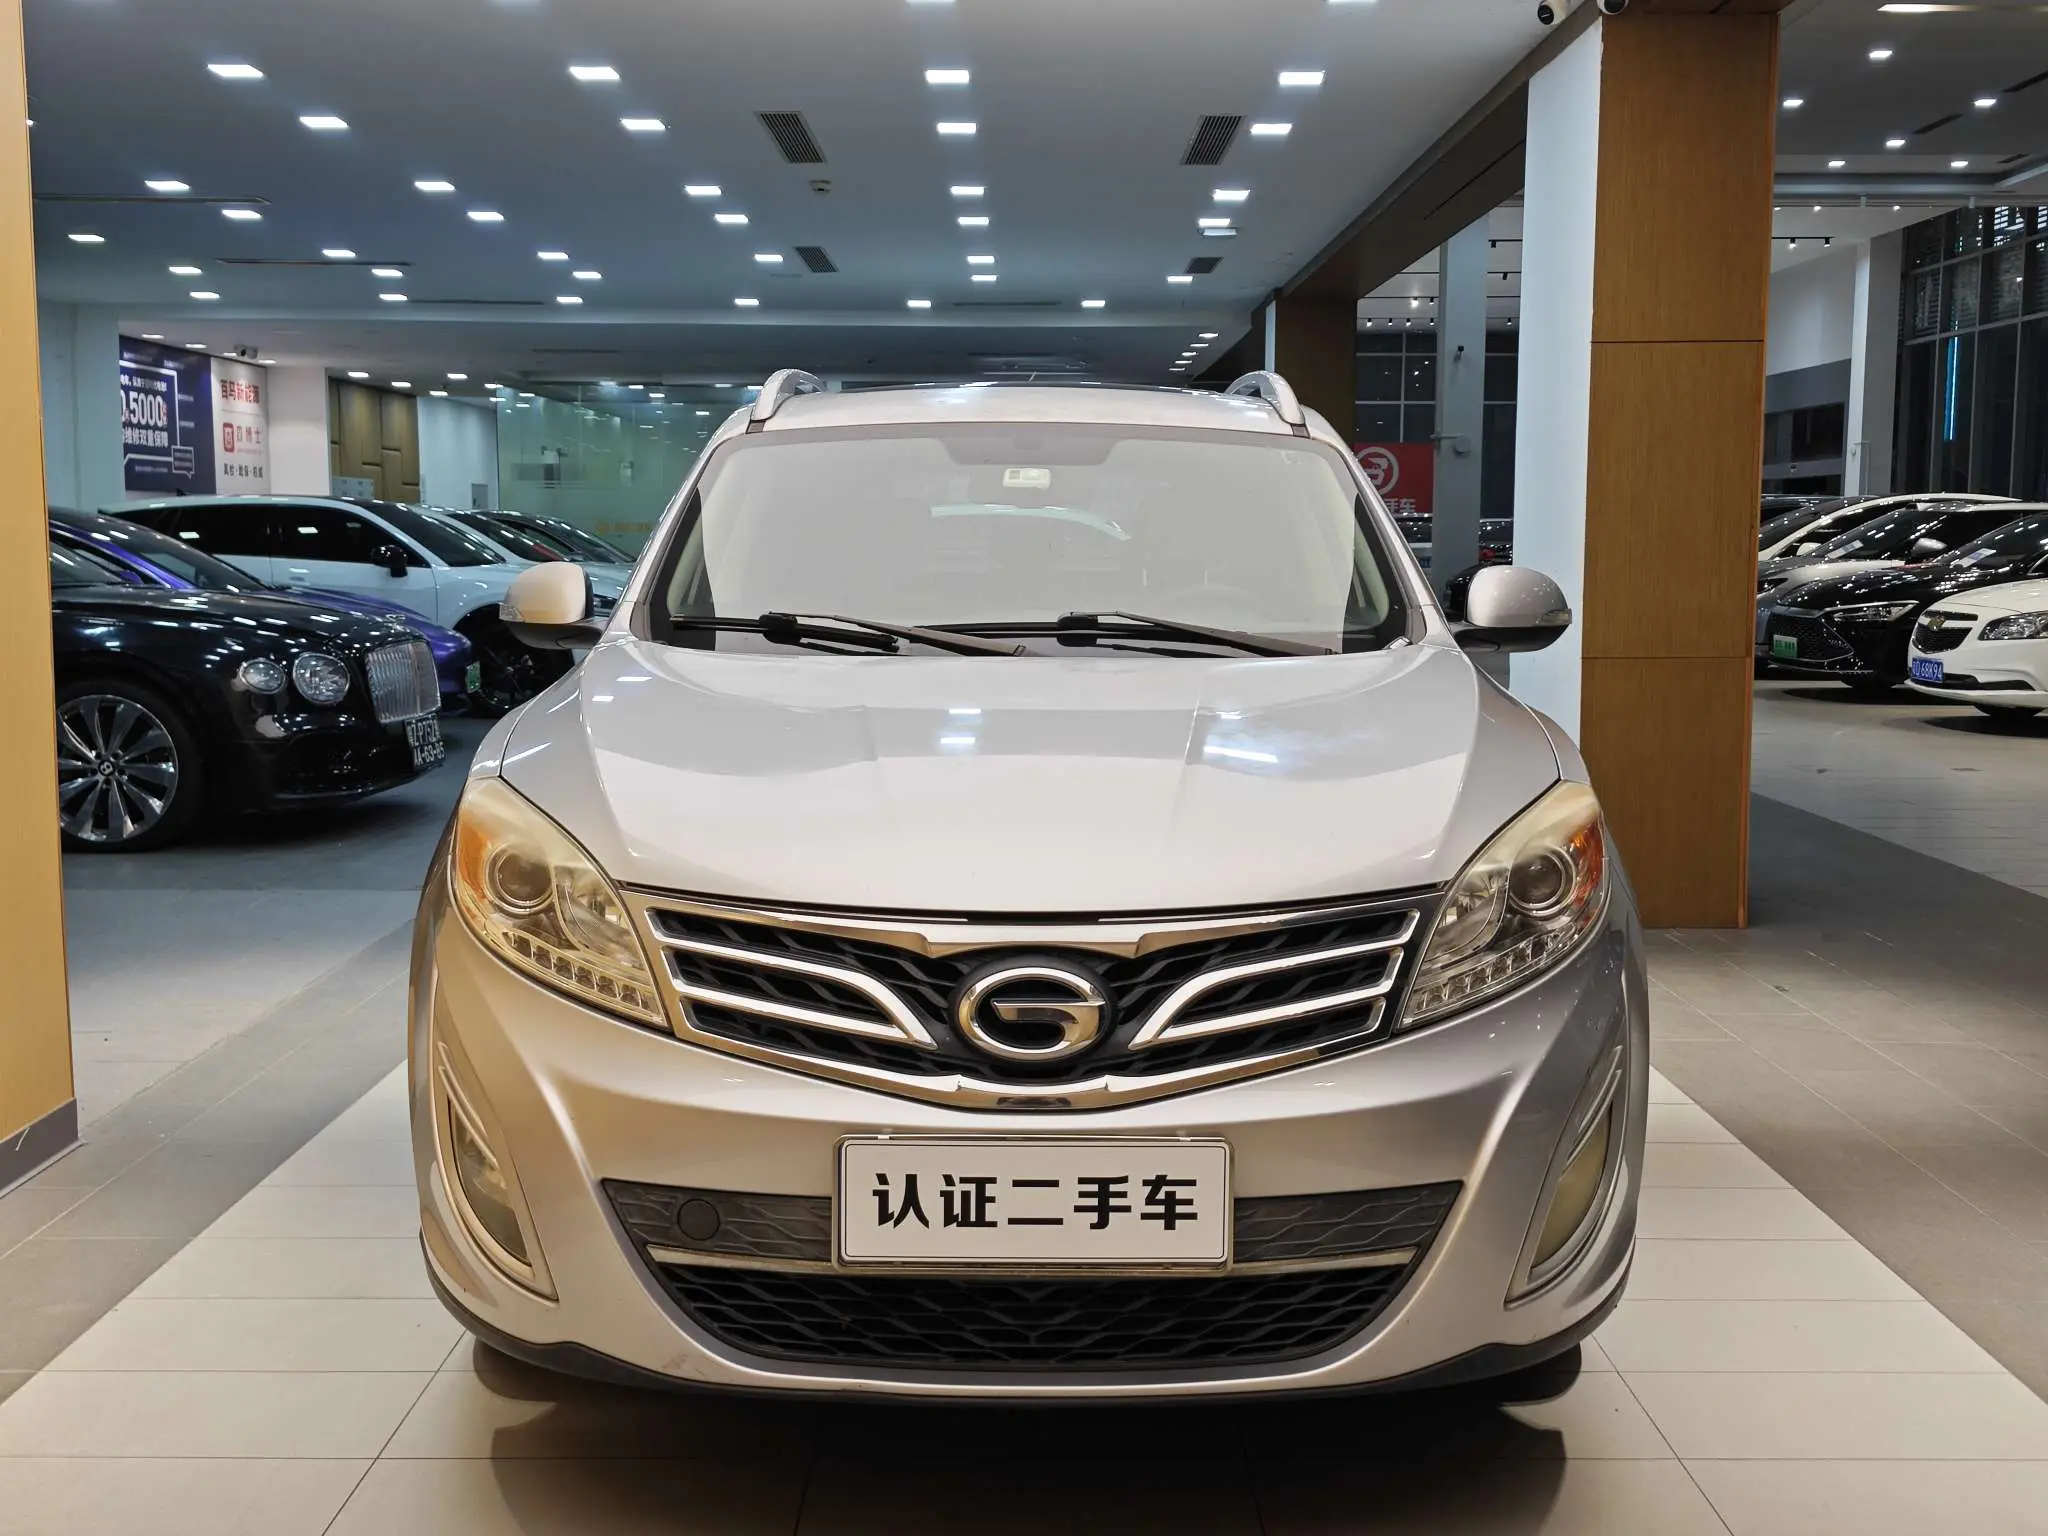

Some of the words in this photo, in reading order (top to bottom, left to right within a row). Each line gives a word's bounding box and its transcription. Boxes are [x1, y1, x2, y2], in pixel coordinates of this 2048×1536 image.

[873, 1172, 1198, 1231] 认证二手车
